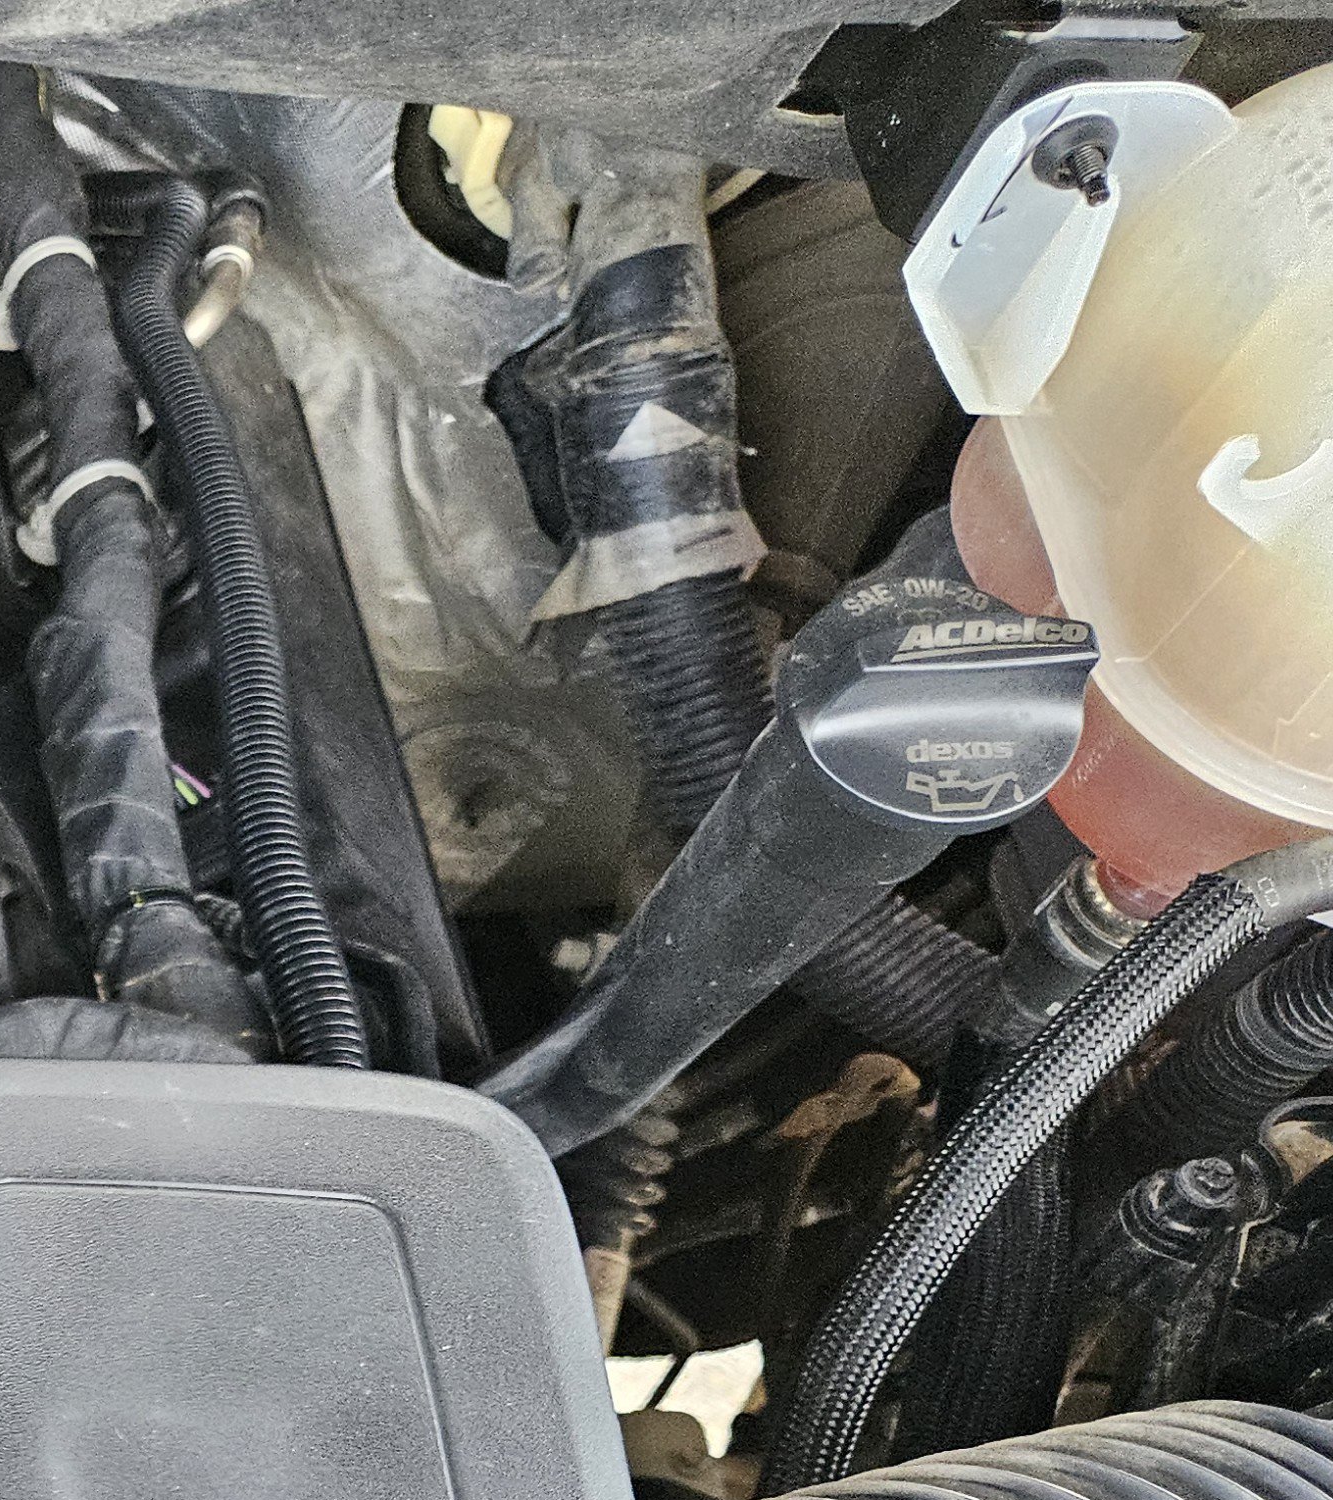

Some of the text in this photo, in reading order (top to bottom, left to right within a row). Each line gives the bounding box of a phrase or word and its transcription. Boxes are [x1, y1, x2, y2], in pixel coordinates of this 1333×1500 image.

[842, 577, 989, 617] SAE 0W-20
[896, 618, 1090, 652] ACDelco
[905, 739, 1014, 762] dexos
